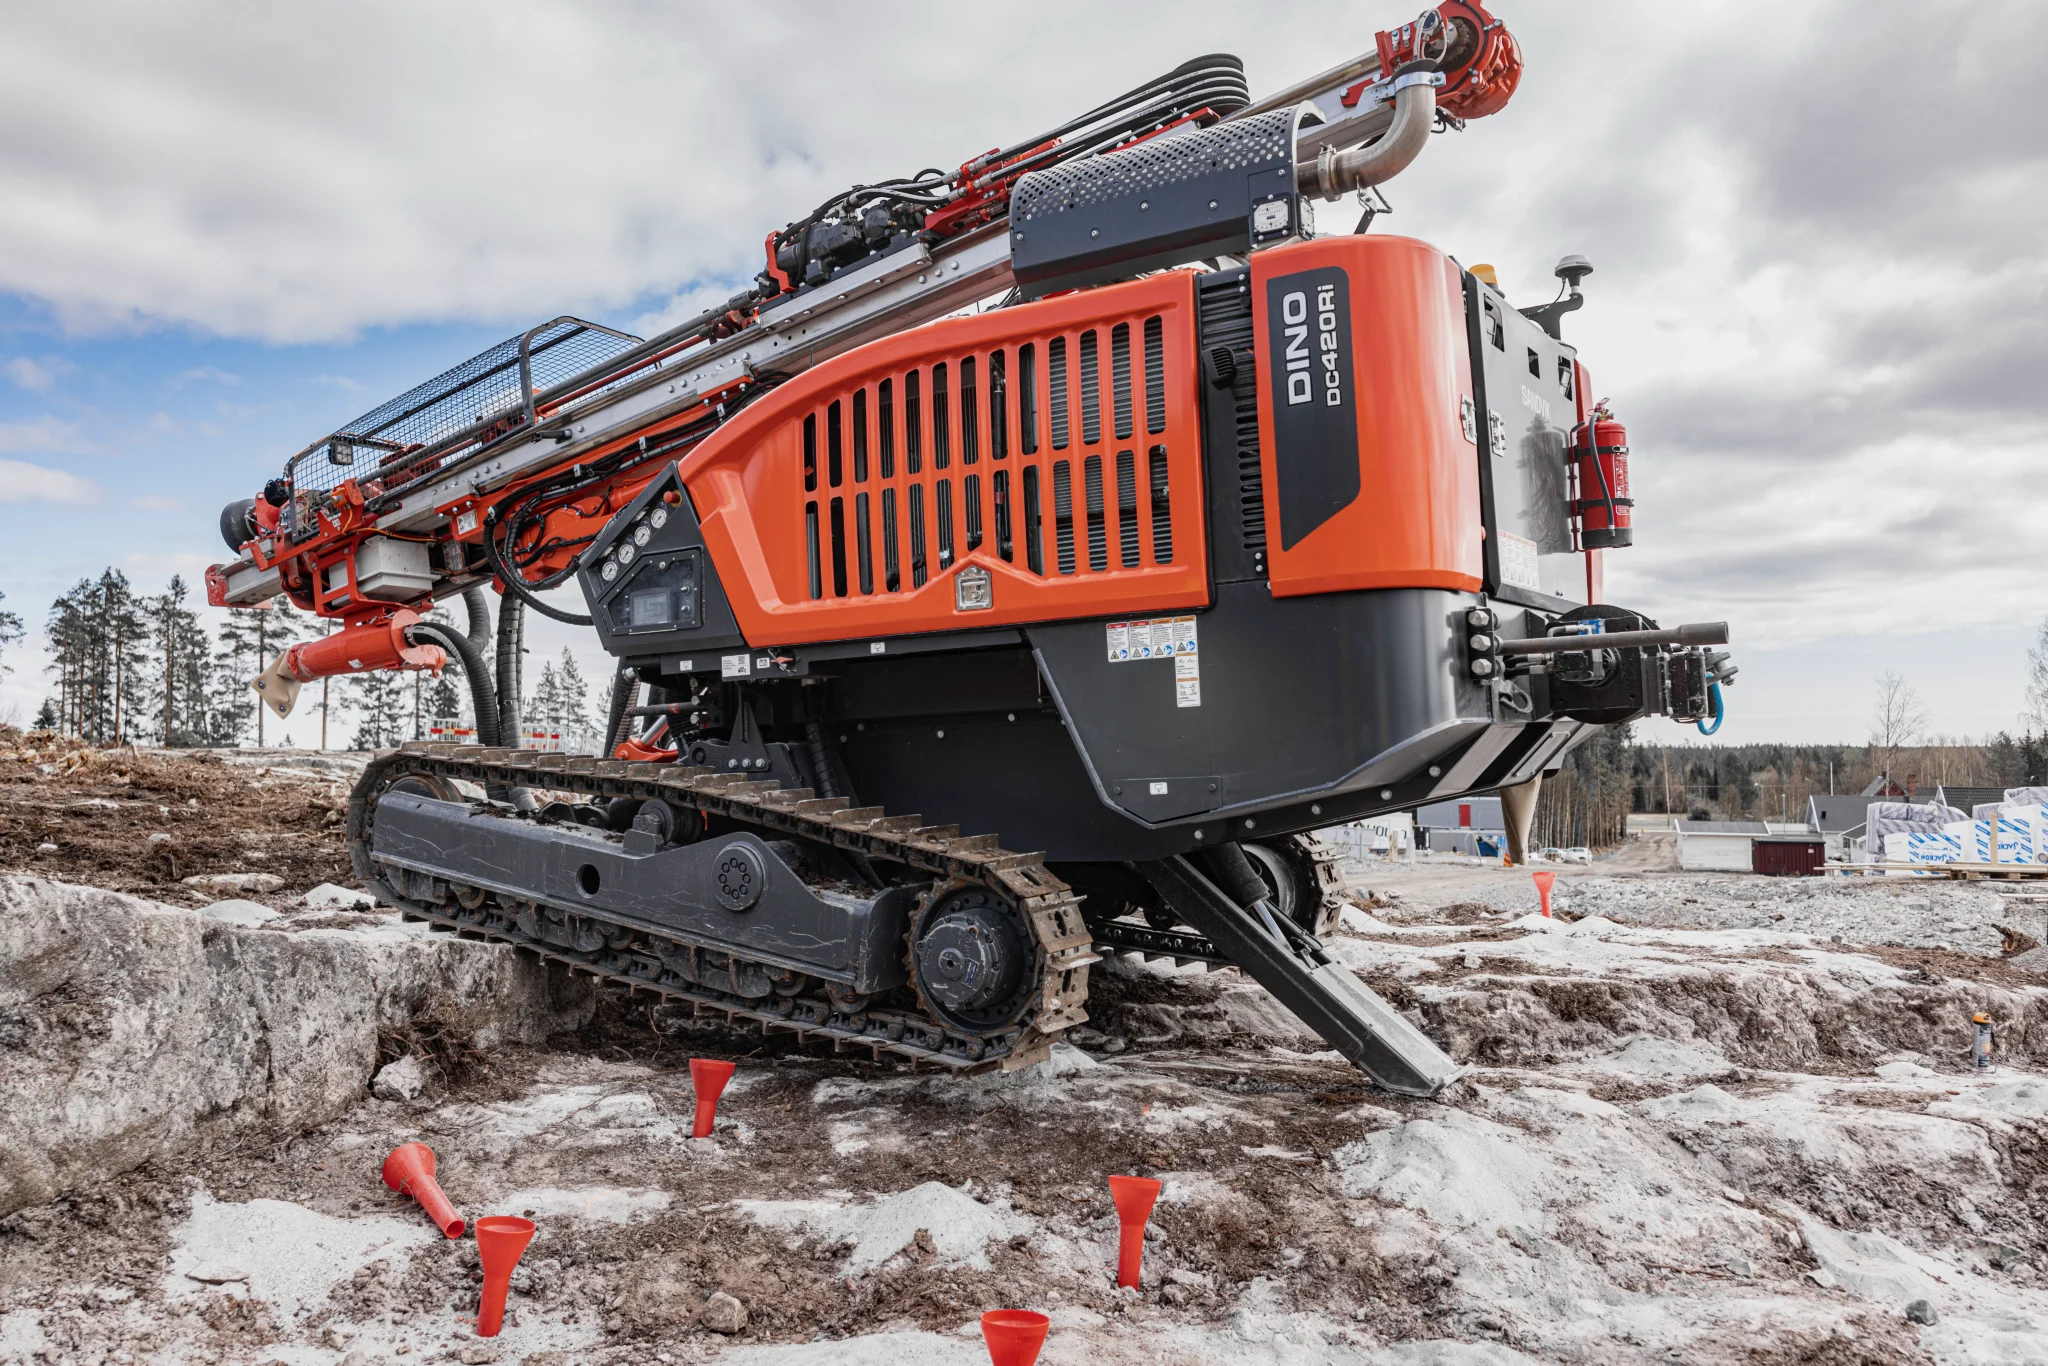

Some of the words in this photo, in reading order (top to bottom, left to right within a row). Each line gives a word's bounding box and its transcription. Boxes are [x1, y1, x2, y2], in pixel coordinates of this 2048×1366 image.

[1282, 291, 1313, 405] DINO
[1317, 284, 1341, 406] DC420Ri
[1521, 384, 1552, 422] SANDVIK
[1997, 841, 2019, 850] JACKO
